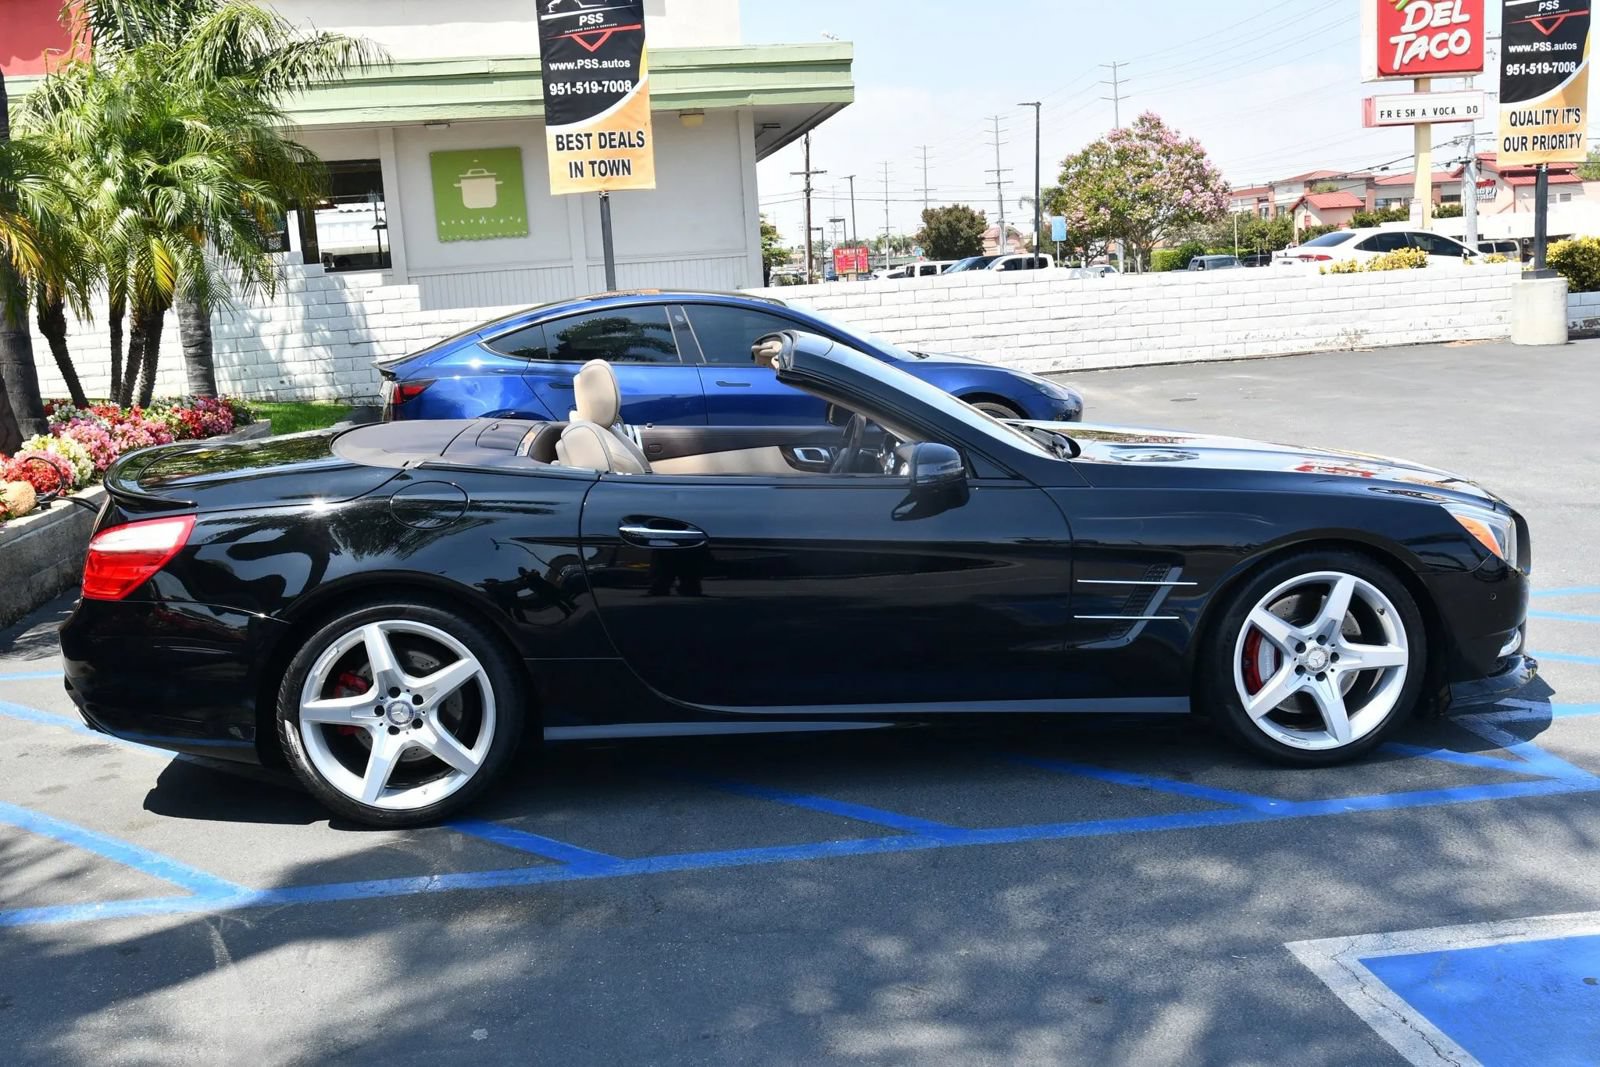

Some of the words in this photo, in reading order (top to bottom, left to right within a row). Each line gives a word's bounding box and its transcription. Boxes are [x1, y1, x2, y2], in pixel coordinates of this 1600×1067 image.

[1538, 0, 1559, 12] PSS
[579, 13, 604, 26] PSS
[1401, 0, 1470, 33] DEL
[1389, 28, 1472, 71] TACO
[1508, 42, 1577, 54] www.PSS.autos
[549, 58, 631, 71] www.PSS.autos
[1506, 61, 1576, 76] 951-519-7008
[549, 80, 632, 96] 951-519-7008
[1510, 109, 1557, 127] QUALITY
[1562, 107, 1581, 124] IT'S
[555, 132, 593, 152] BEST
[598, 130, 645, 150] DEALS
[1503, 135, 1527, 153] OUR
[1532, 133, 1583, 151] PRIORITY
[569, 160, 584, 179] IN
[588, 159, 632, 178] TOWN
